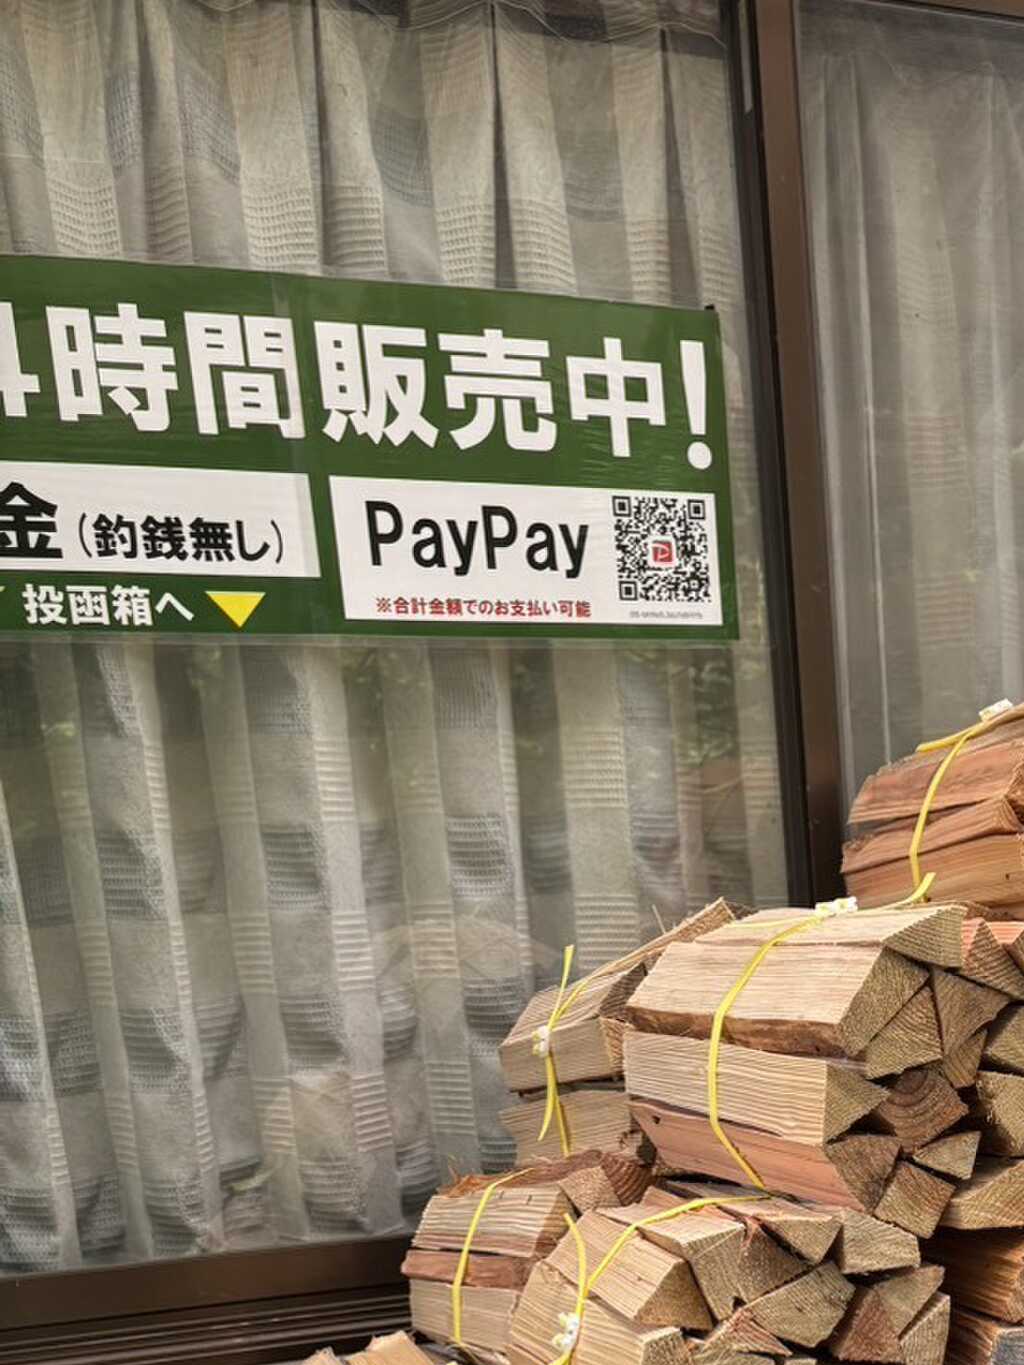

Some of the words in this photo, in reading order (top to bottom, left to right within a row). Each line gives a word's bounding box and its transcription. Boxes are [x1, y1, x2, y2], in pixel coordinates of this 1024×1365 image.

[365, 500, 590, 579] PayPay
[22, 583, 194, 626] 投函箱へ
[376, 596, 592, 618] ※合計金額でのお支払い可能
